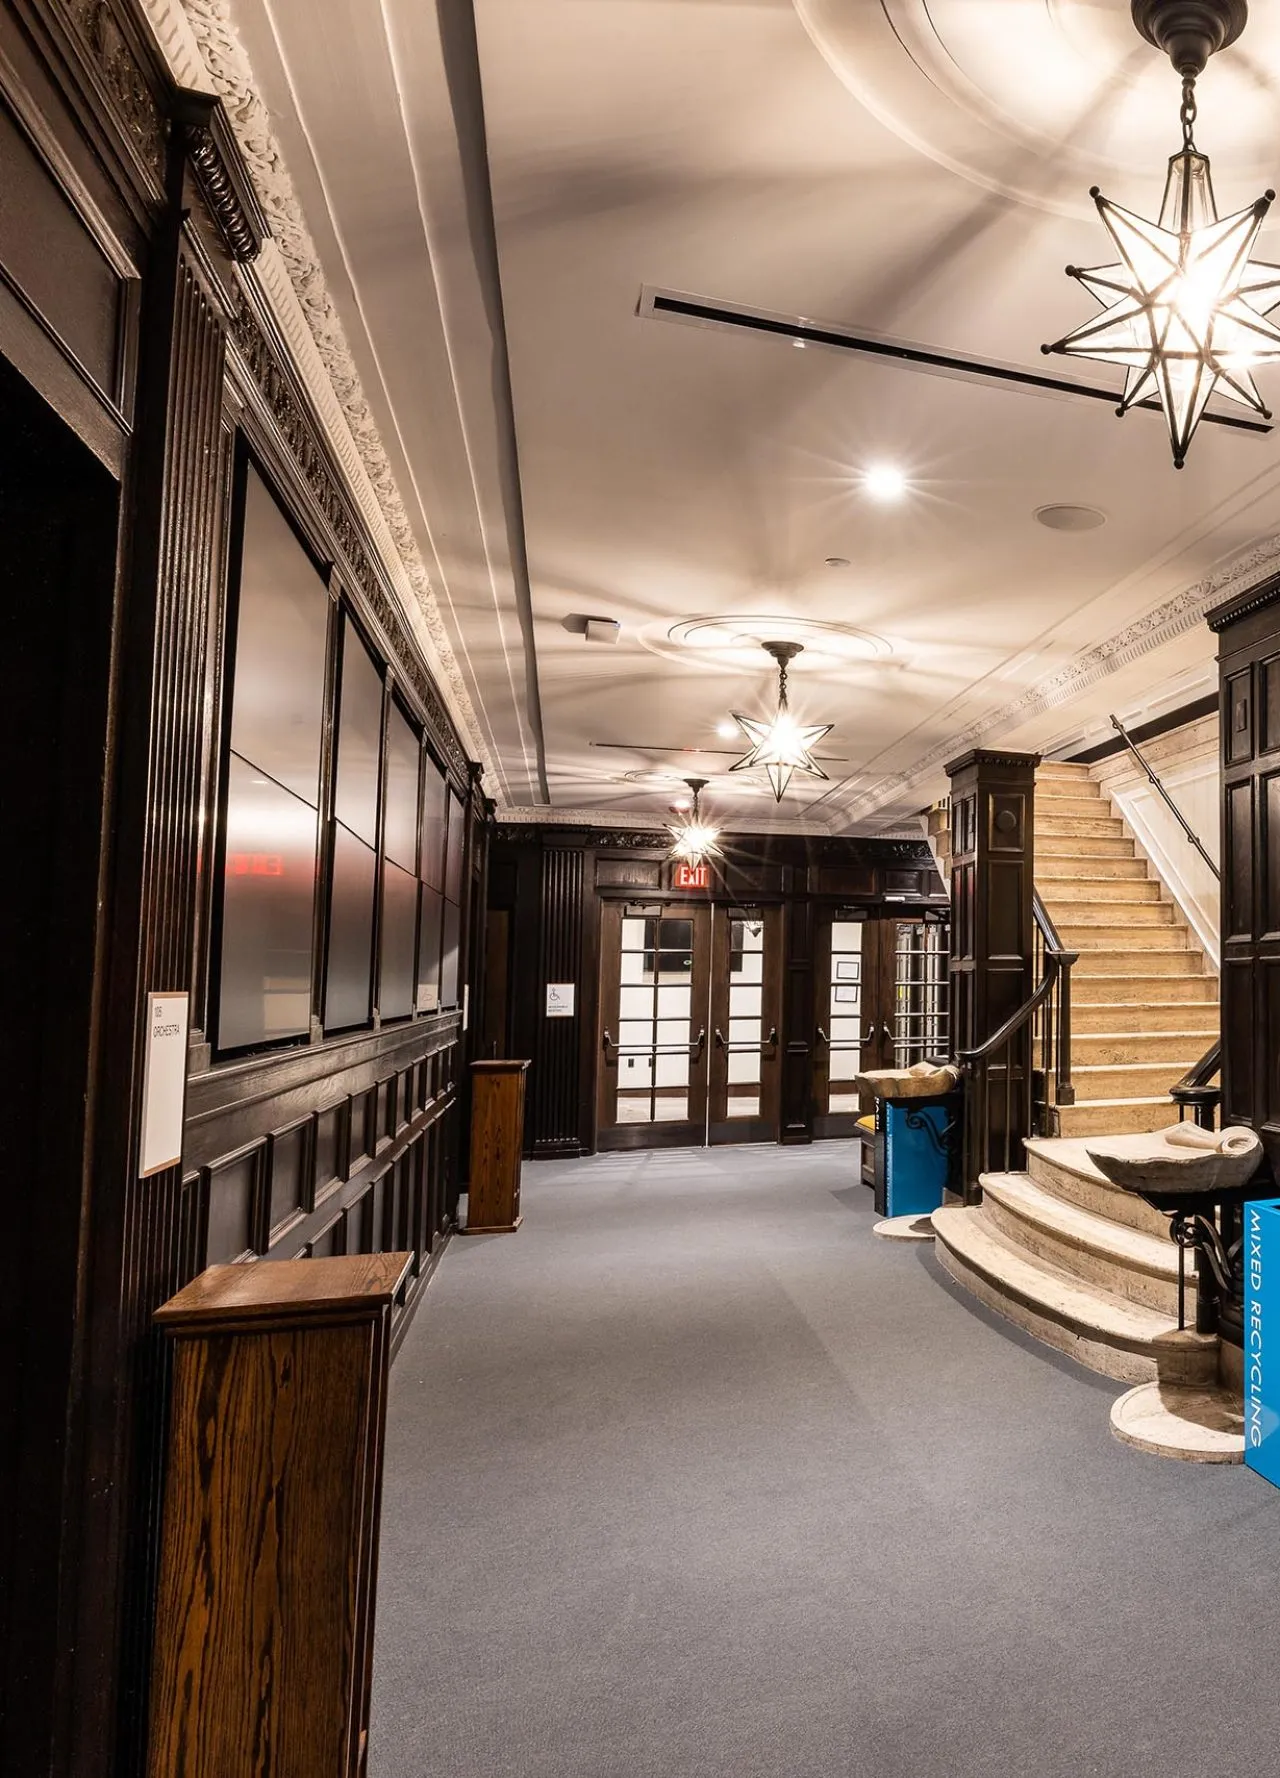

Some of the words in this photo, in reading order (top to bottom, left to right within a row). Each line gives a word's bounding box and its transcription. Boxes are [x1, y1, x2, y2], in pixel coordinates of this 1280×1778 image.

[680, 866, 707, 885] EXIT
[153, 1024, 179, 1037] ORCHESTRA
[1250, 1208, 1262, 1291] MIXED
[1250, 1299, 1262, 1448] RECYCLING
